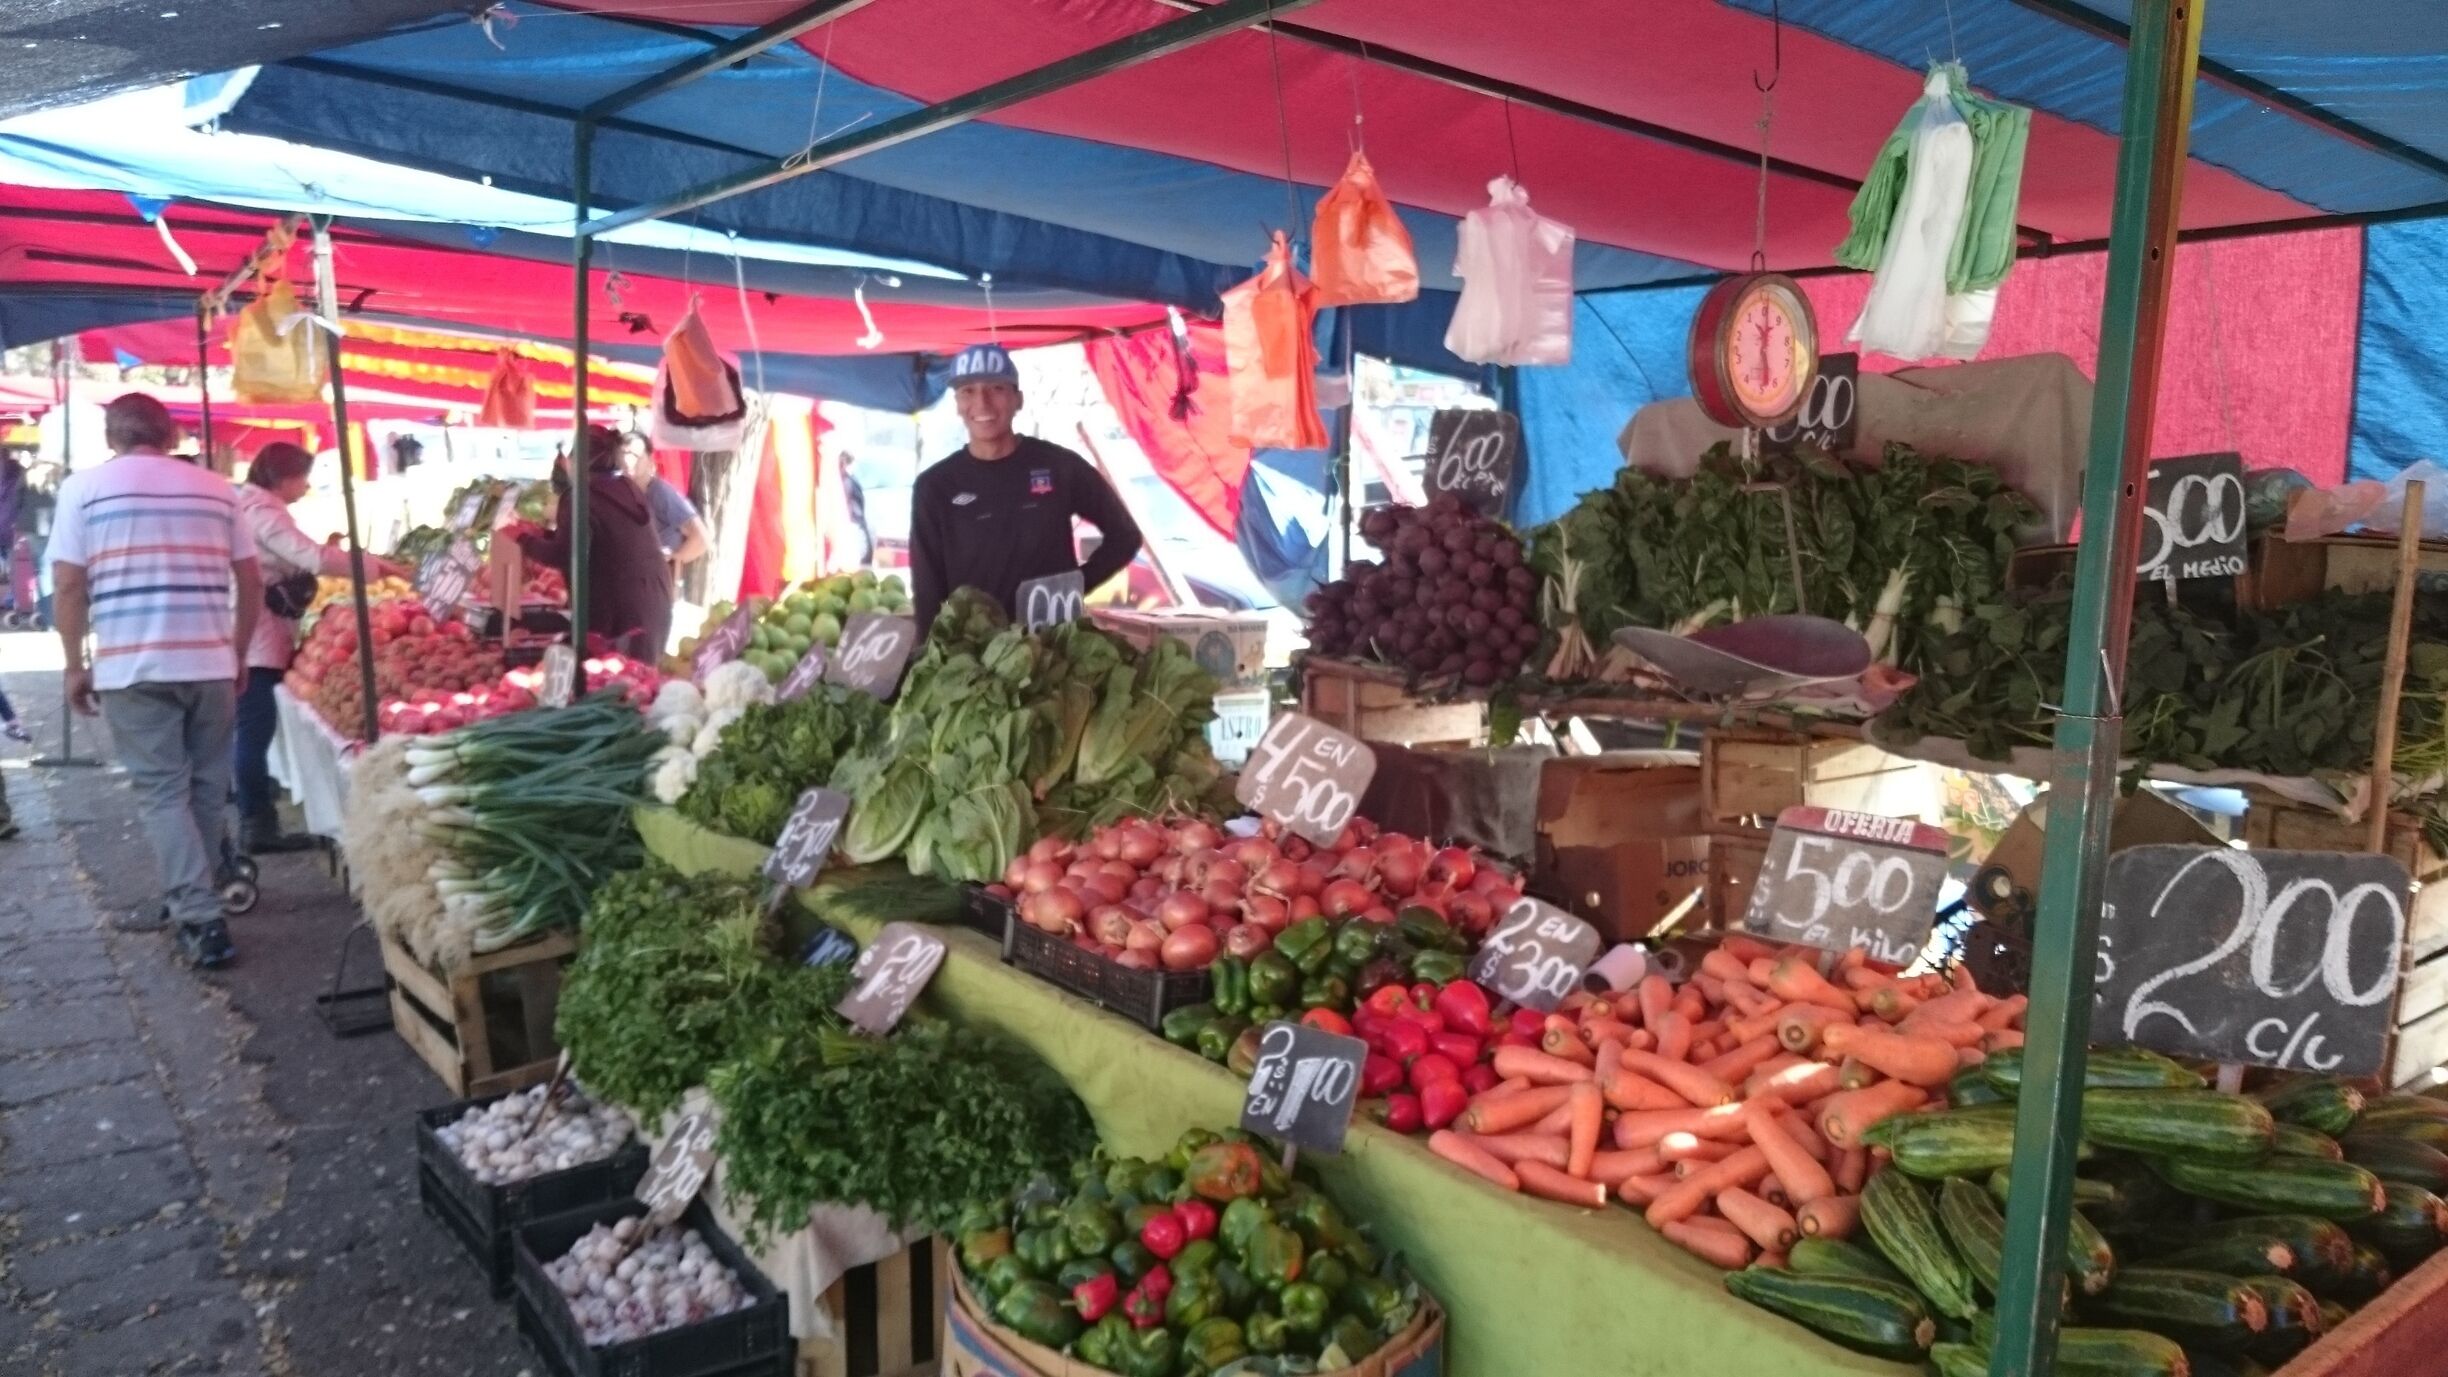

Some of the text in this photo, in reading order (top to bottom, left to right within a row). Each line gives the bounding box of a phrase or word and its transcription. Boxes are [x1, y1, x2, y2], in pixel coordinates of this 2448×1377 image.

[1437, 409, 1504, 491] 600
[1255, 711, 1357, 783] 4 EN
[1271, 755, 1354, 831] 500
[1823, 808, 1916, 844] OFERTA
[1775, 836, 1914, 929] 500
[1484, 897, 1584, 955] 2 EN
[2121, 848, 2406, 1041] 200
[1497, 940, 1580, 999] 300
[1248, 1026, 1295, 1096] 2
